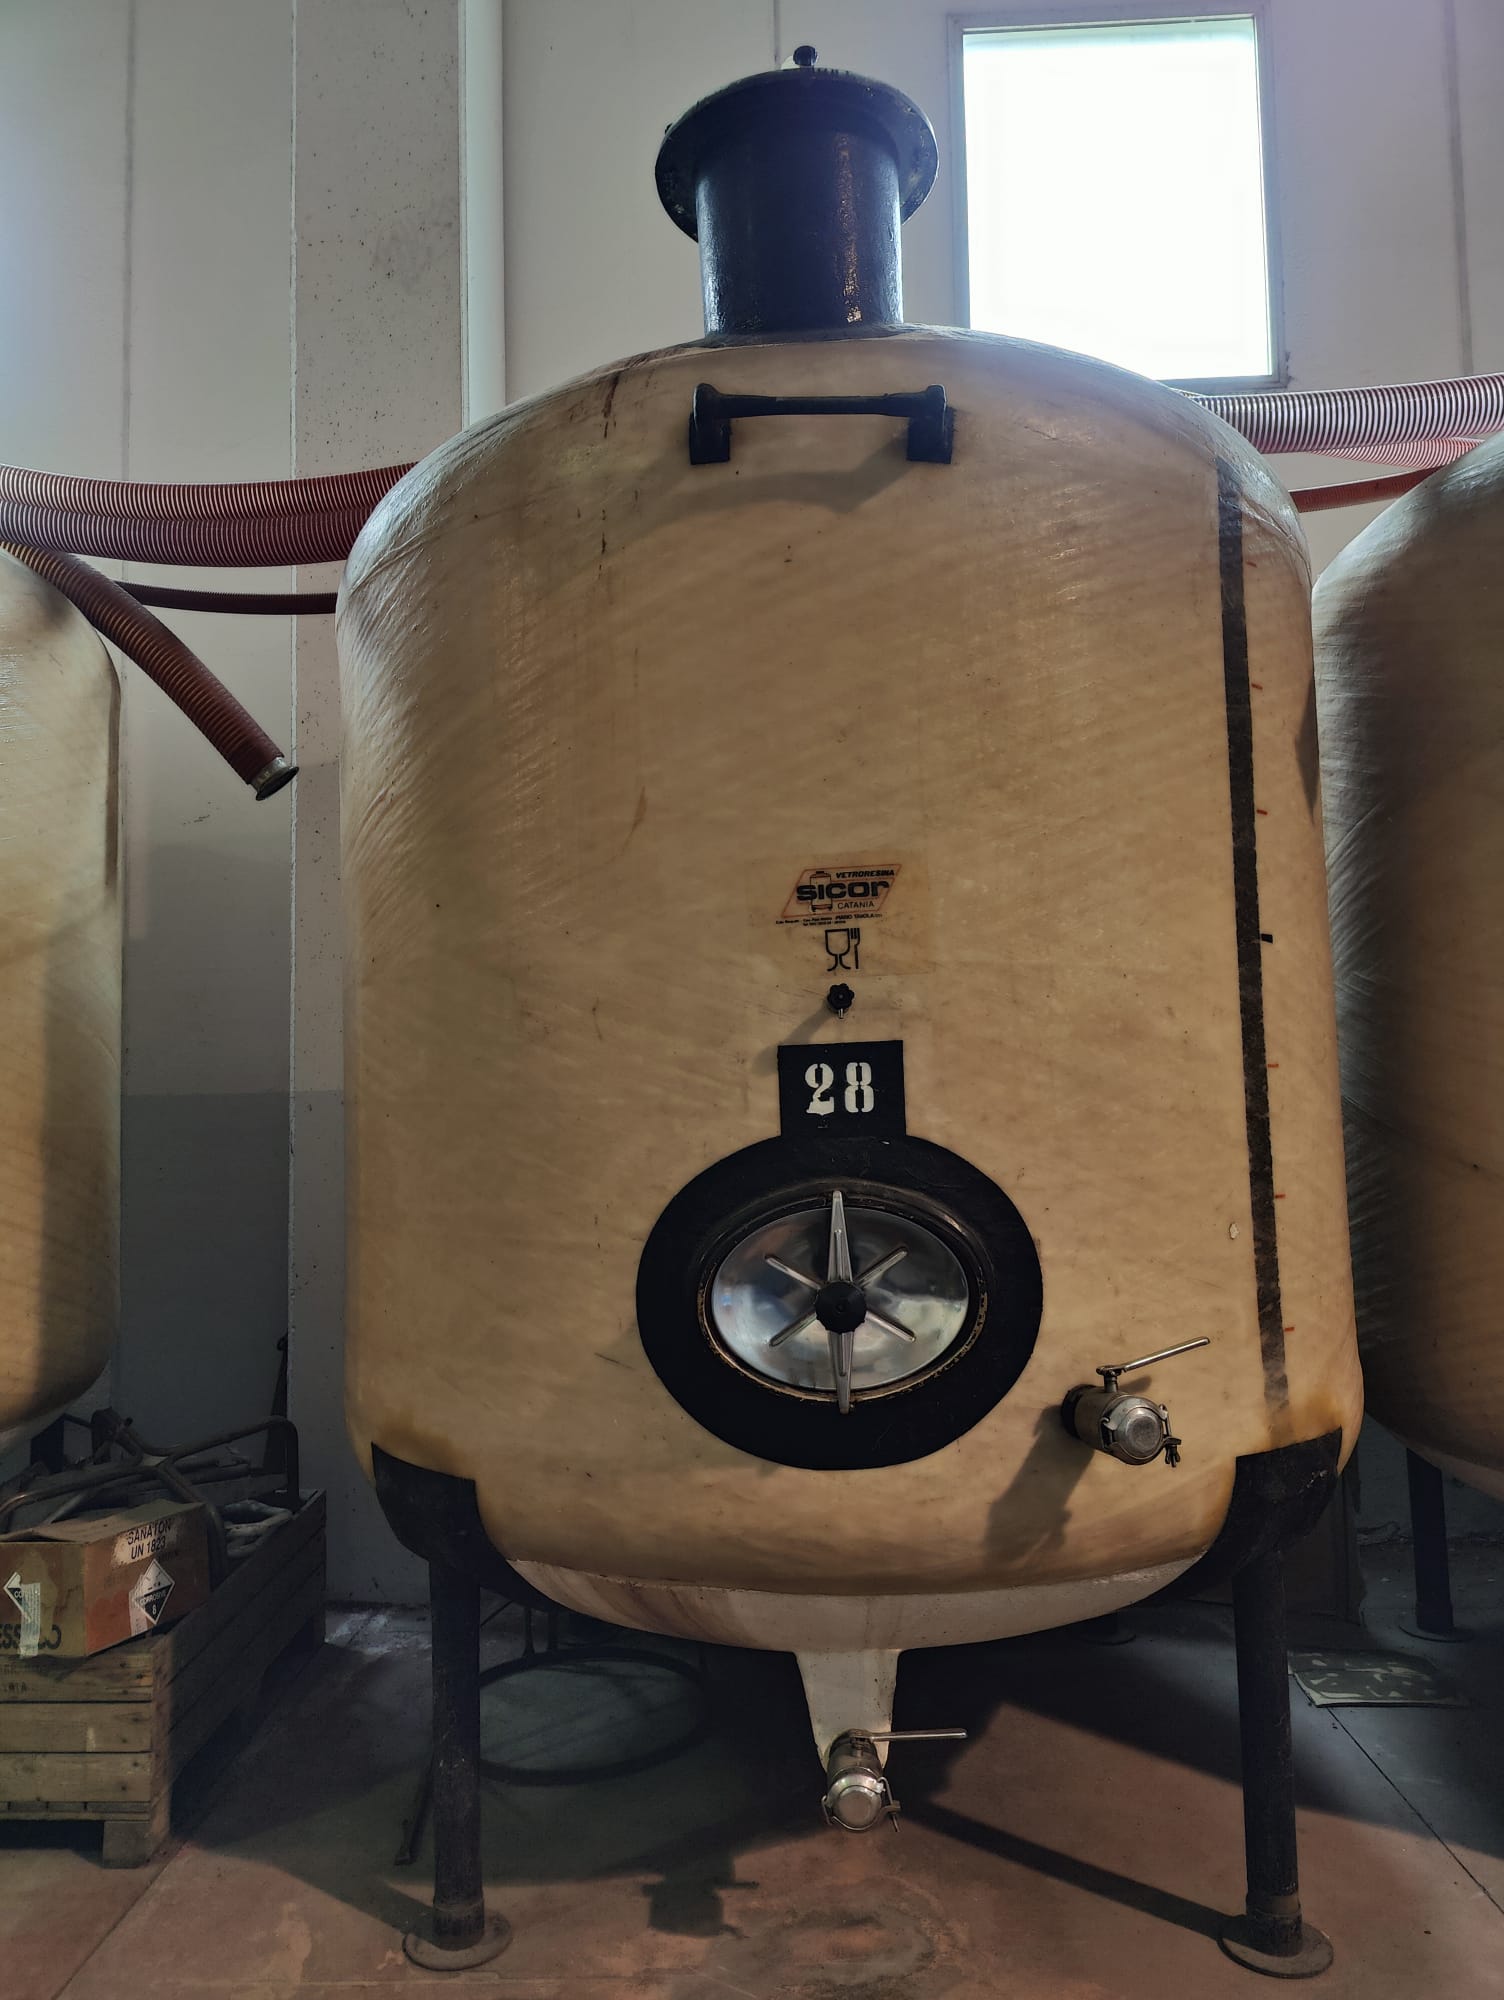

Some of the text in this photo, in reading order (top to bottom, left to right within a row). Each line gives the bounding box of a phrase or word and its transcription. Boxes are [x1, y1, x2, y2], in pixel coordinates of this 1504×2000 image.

[835, 869, 894, 879] VETRORESINA
[837, 901, 875, 910] CATANIA
[805, 1062, 874, 1115] 28
[131, 1543, 144, 1560] UN
[147, 1536, 166, 1553] 1823
